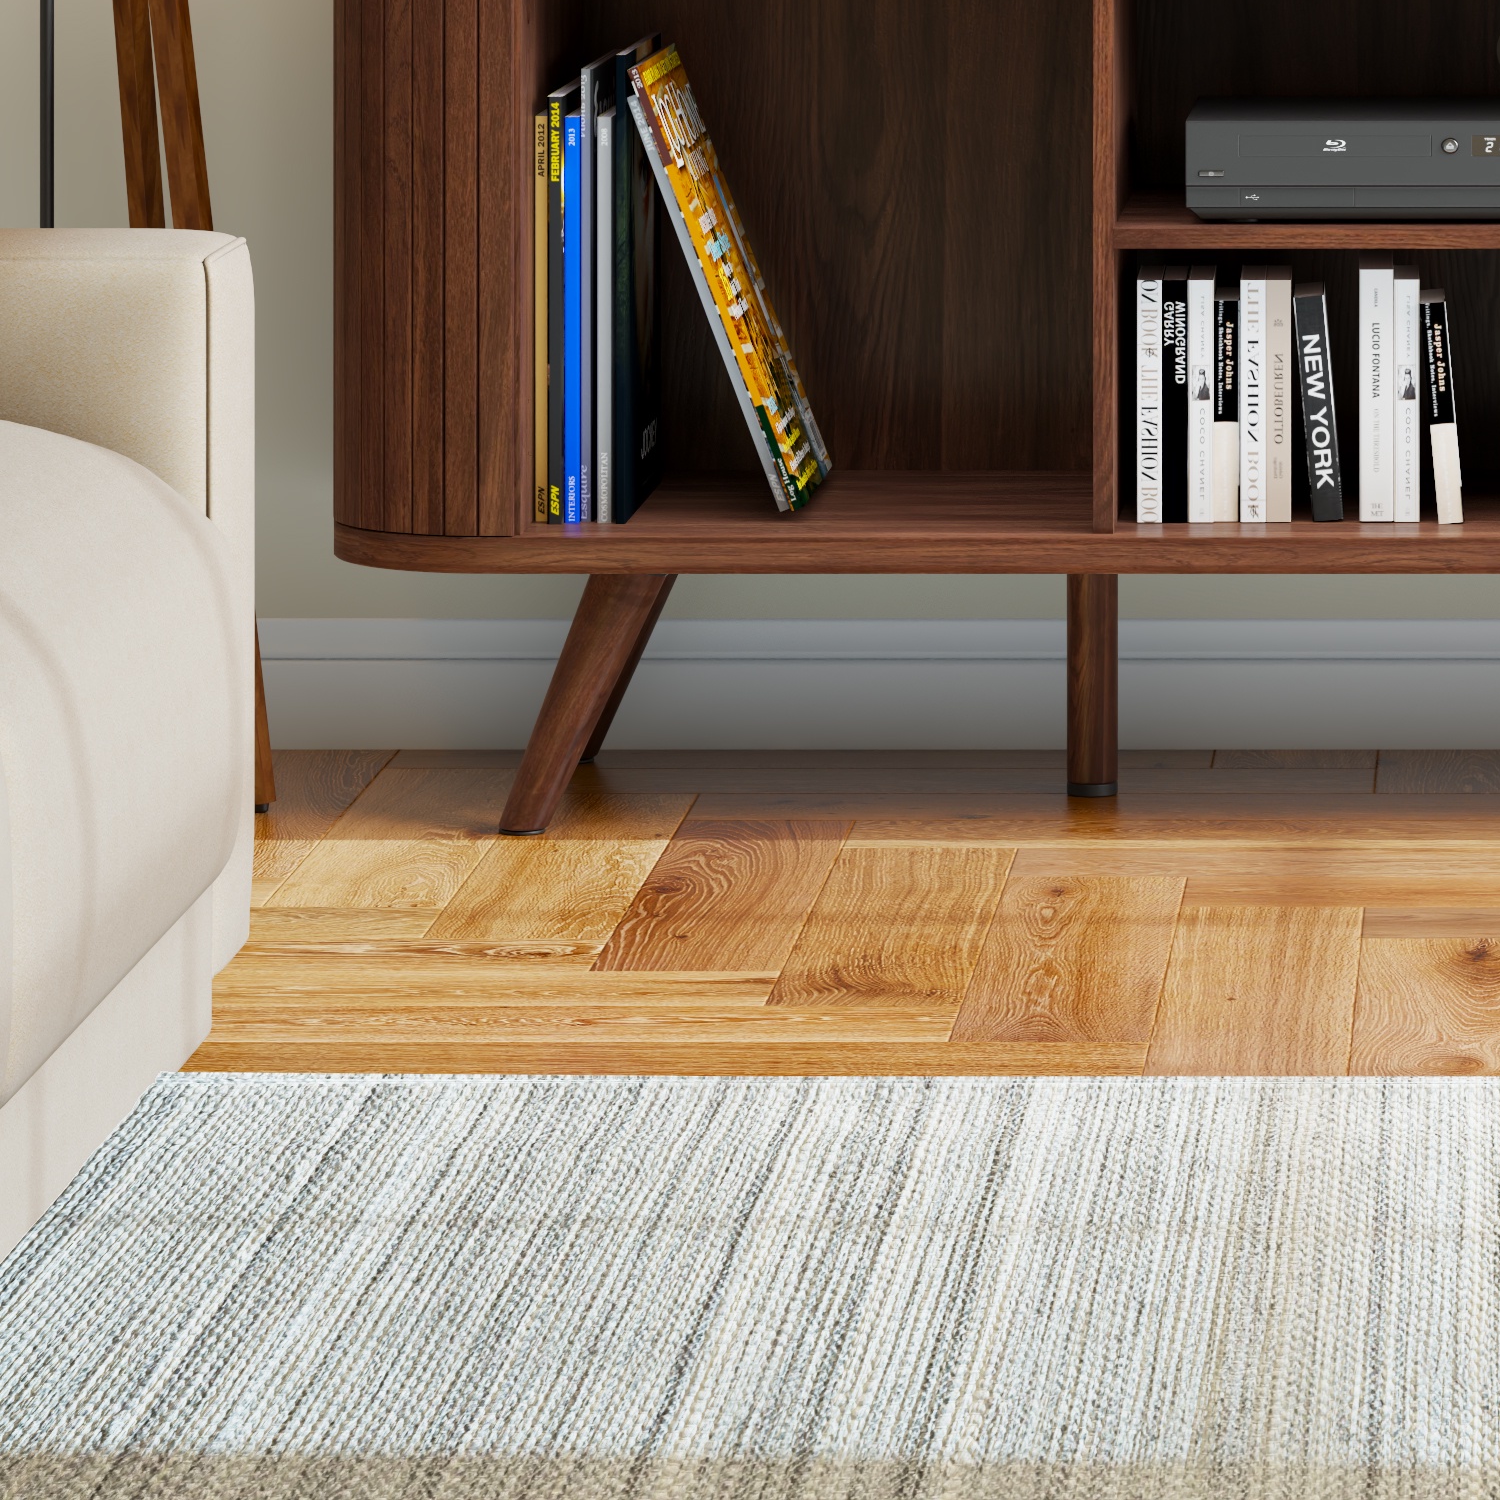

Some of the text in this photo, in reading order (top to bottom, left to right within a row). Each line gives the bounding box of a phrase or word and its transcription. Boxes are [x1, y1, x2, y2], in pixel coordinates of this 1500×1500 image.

[631, 68, 643, 89] 2013
[1485, 141, 1494, 153] 2
[537, 123, 545, 514] ESPN APRIL 2012
[550, 102, 560, 516] ESPN FEBRUARY 2014
[568, 128, 576, 522] INTERIORS 2013
[600, 128, 608, 522] COSMOPOLITAN 2008
[630, 99, 786, 501] ESPN JUNE 2014
[1224, 321, 1234, 390] Jasper Johns
[1371, 322, 1380, 398] LUCIO FONTANA
[1427, 329, 1435, 364] Sketchbook
[1431, 385, 1439, 417] Interviews
[1433, 323, 1446, 392] Jasper Johns
[1301, 333, 1335, 490] NEW YORK
[777, 458, 797, 502] Log House
